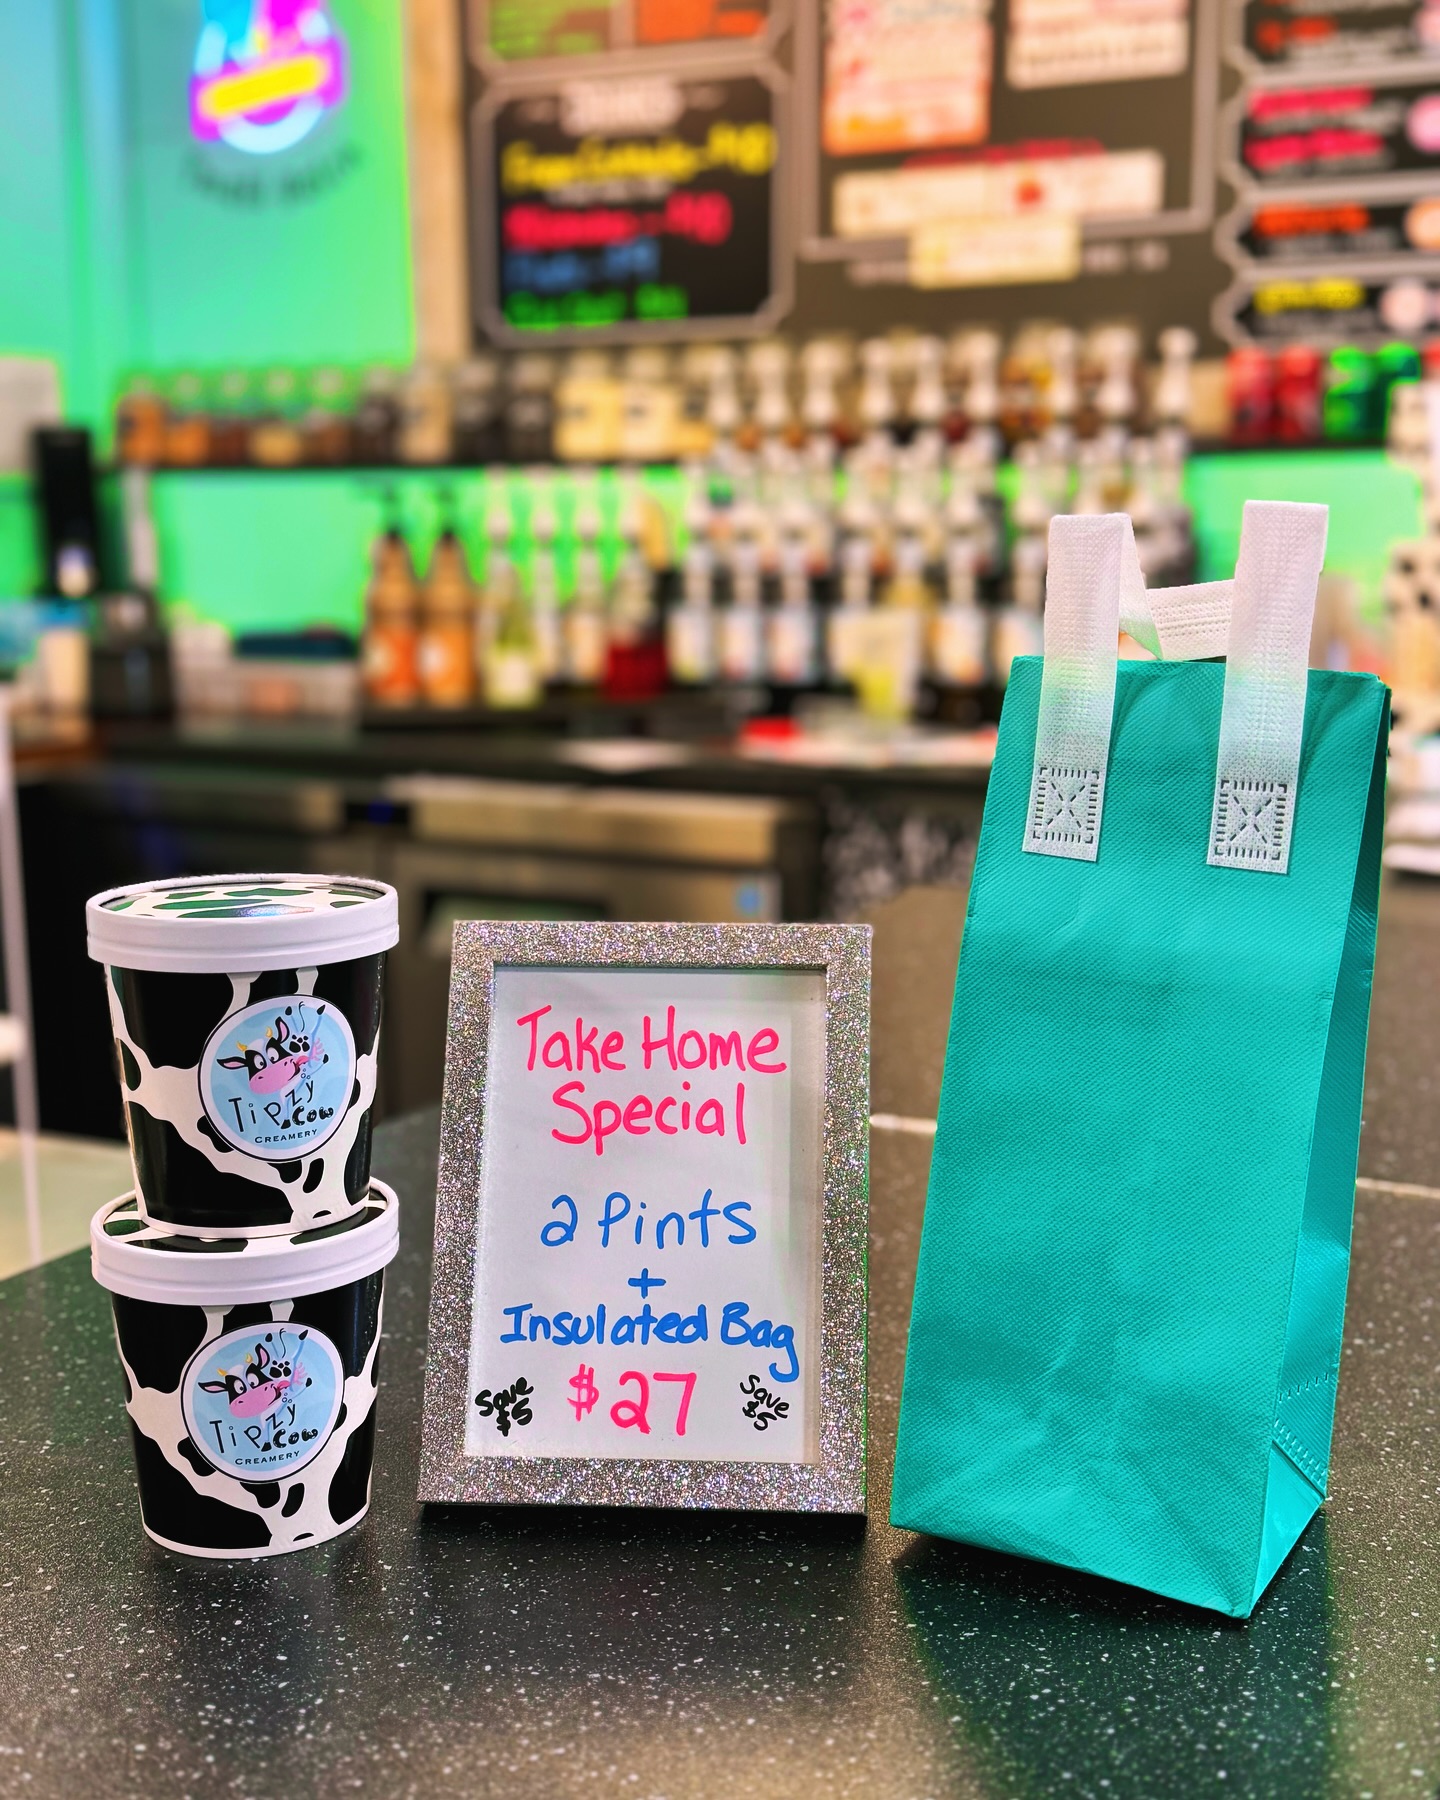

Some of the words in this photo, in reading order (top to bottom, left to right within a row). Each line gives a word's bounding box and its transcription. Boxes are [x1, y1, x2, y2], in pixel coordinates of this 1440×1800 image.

[516, 1004, 627, 1074] Take
[640, 1005, 788, 1075] Home
[254, 1128, 318, 1144] CREAMERY
[292, 1106, 334, 1126] Cow
[550, 1080, 747, 1157] Special
[540, 1194, 578, 1247] 2
[597, 1189, 757, 1249] Pints
[627, 1268, 666, 1299] +
[499, 1303, 708, 1347] Insulated
[719, 1301, 799, 1384] Bag
[475, 1376, 535, 1418] Save
[566, 1363, 697, 1437] $27
[739, 1374, 790, 1419] Save
[234, 1450, 300, 1466] CREAMERY
[273, 1428, 319, 1449] Cow
